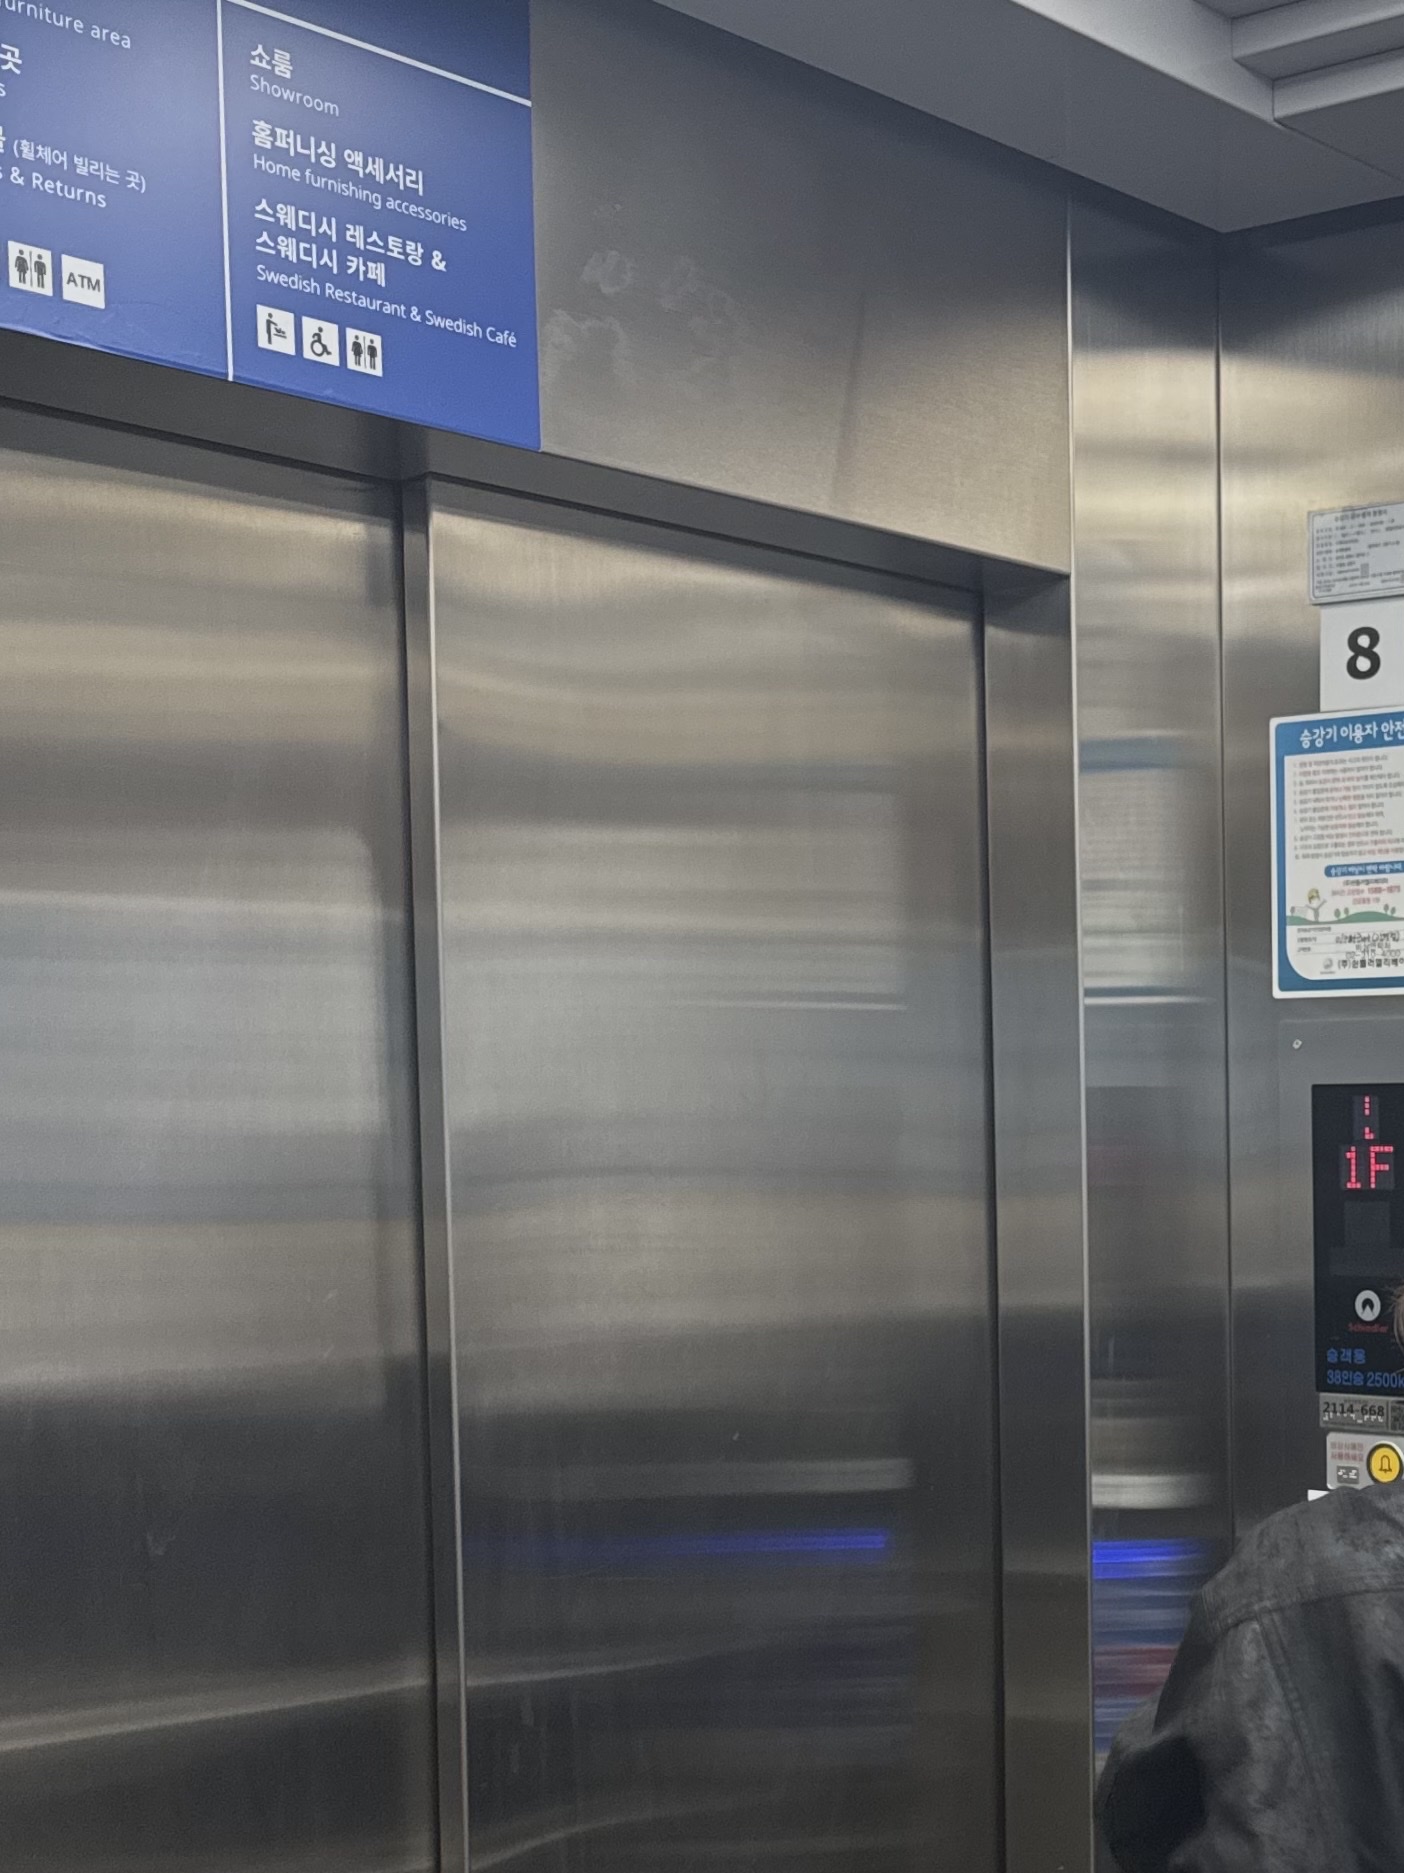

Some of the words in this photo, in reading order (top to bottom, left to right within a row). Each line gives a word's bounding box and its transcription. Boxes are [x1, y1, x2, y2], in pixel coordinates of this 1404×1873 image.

[0, 0, 84, 34] urniture
[90, 25, 131, 49] area
[250, 43, 293, 79] 쇼룸
[250, 74, 340, 117] Showroom
[13, 139, 68, 171] (휠체어
[73, 154, 120, 185] 빌리는
[125, 169, 146, 193] 곳)
[252, 119, 337, 168] 홈퍼니싱
[344, 148, 424, 196] 액세서리
[10, 166, 25, 186] &
[32, 171, 107, 208] Returns
[253, 153, 301, 182] Home
[305, 168, 382, 210] furnishing
[386, 195, 468, 232] accessories
[254, 198, 337, 243] 스웨디시
[345, 223, 424, 267] 레스토랑
[431, 249, 447, 272] &
[255, 230, 338, 274] 스웨디시
[346, 254, 386, 288] 카페
[66, 271, 101, 293] ATM
[257, 264, 321, 296] Swedish
[325, 281, 407, 322] Restaurant
[410, 305, 422, 323] &
[425, 309, 483, 340] Swedish
[486, 326, 517, 349] Café
[1346, 626, 1381, 680] 8
[1300, 725, 1337, 749] 승강기
[1340, 721, 1378, 744] 이용자
[1345, 1146, 1394, 1189] 1F
[1322, 1401, 1385, 1417] 2114-668
